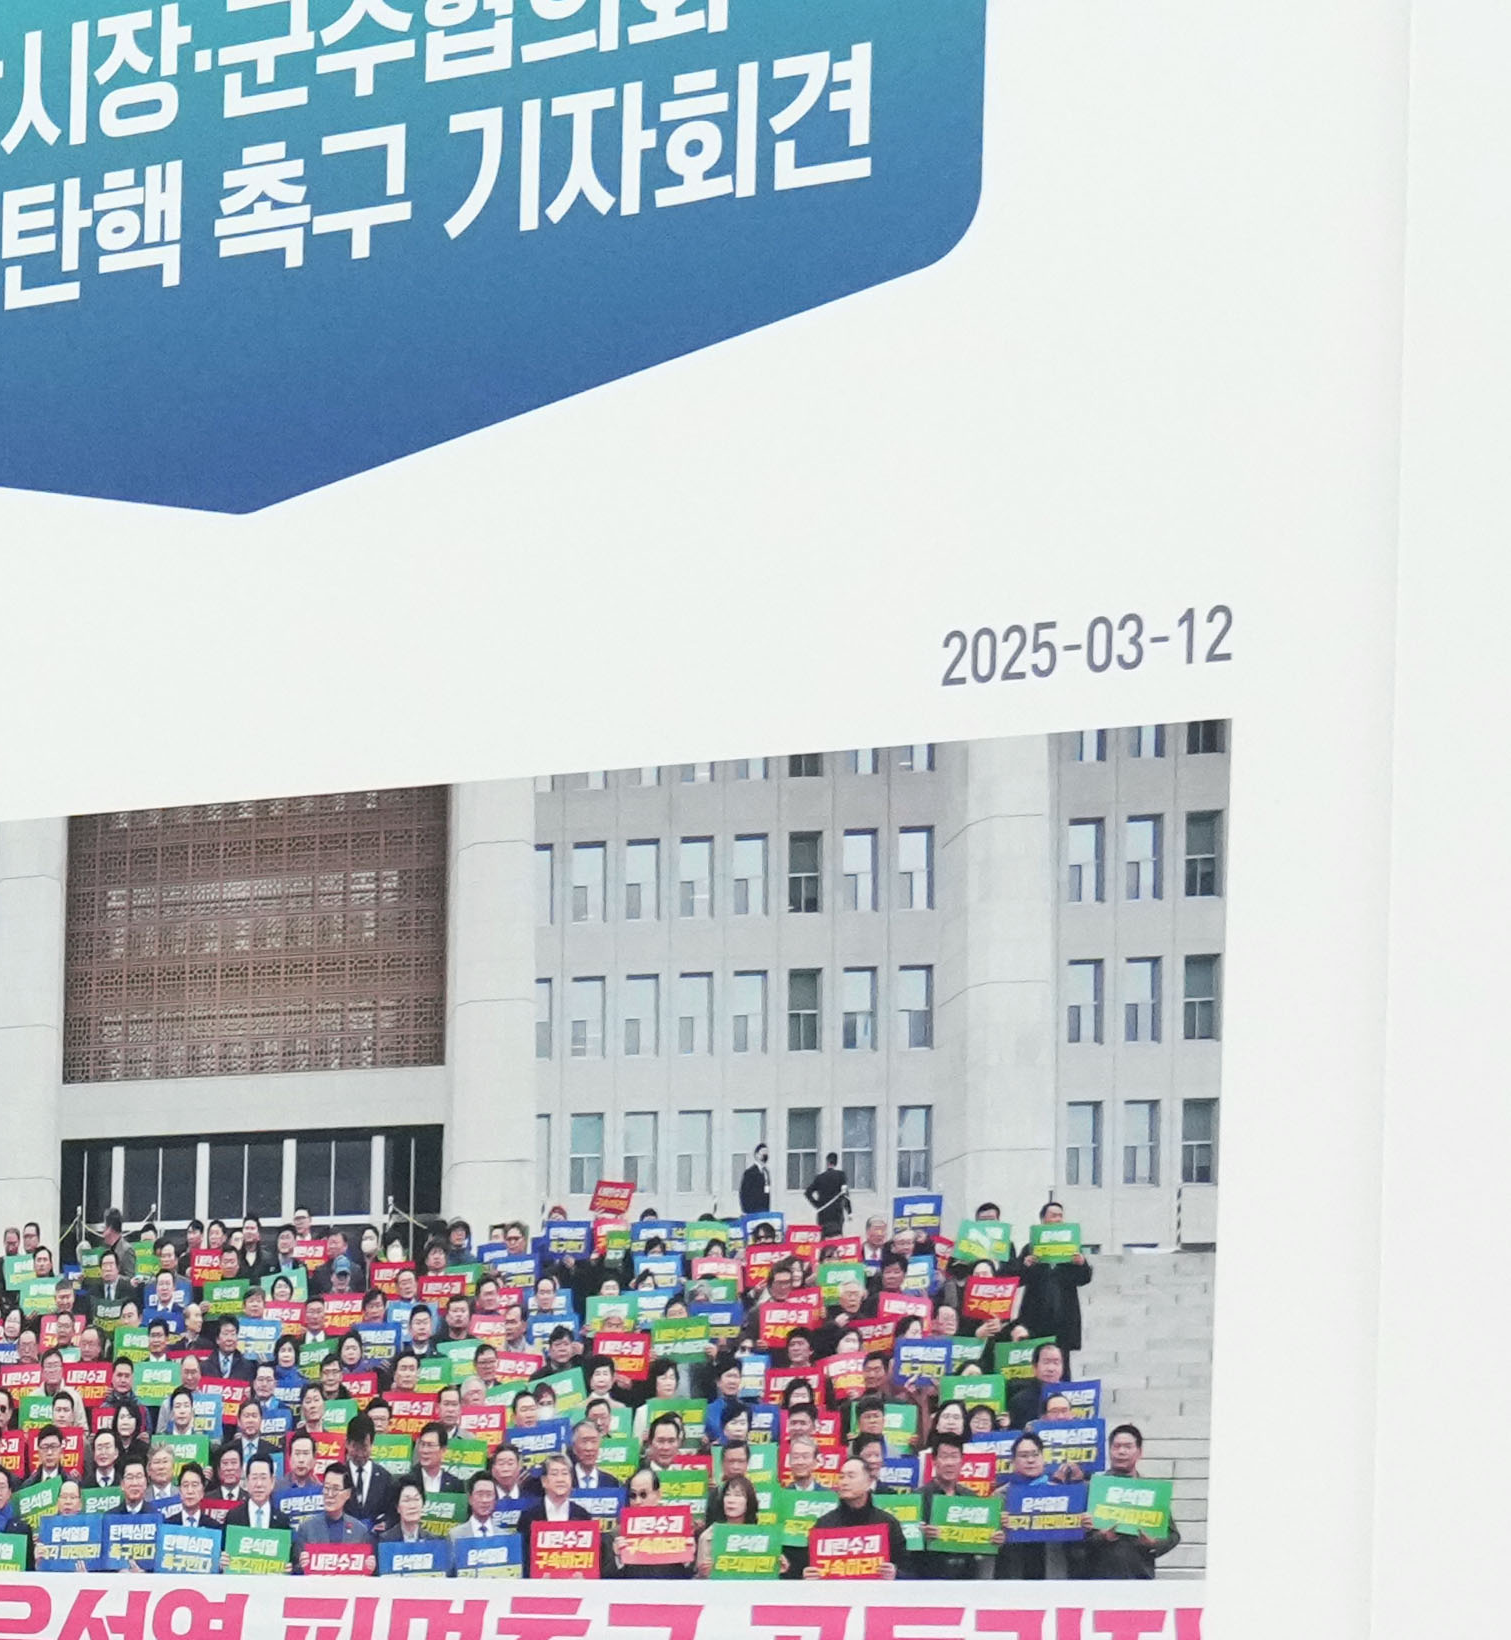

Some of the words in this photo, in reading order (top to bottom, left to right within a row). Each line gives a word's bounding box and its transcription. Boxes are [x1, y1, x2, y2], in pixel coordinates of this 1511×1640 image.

[2, 160, 182, 310] 탄핵
[214, 123, 411, 268] 촉구
[443, 41, 872, 240] 기자회견
[941, 605, 1233, 686] 2025-03-12
[109, 1523, 157, 1541] 탄핵심판
[536, 1530, 593, 1550] 내란수괴
[162, 1534, 213, 1554] 탄핵심판
[238, 1536, 279, 1556] 윤석열
[816, 1534, 883, 1556] 내란수괴
[310, 1552, 364, 1572] 내란수괴
